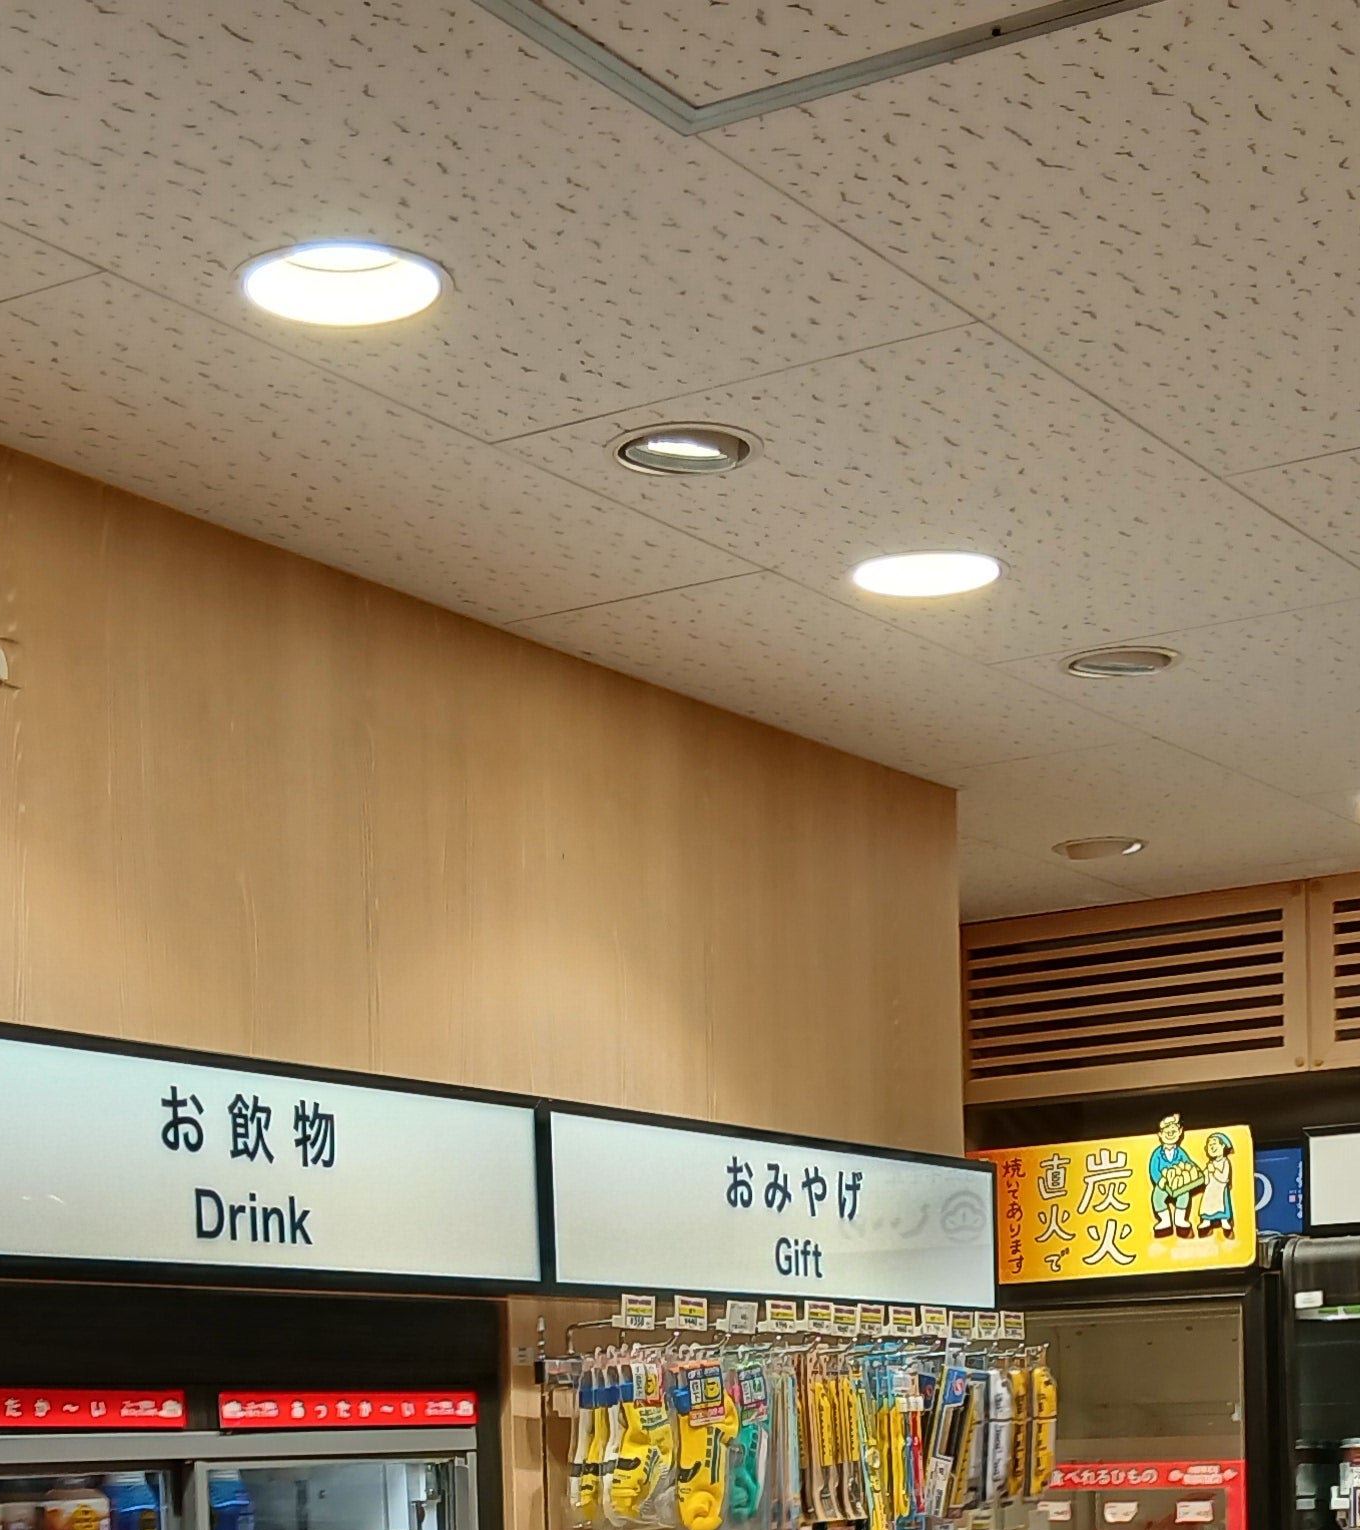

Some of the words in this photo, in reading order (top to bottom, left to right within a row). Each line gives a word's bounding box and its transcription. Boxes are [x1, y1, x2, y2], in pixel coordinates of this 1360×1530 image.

[161, 1086, 338, 1169] お飲物
[195, 1187, 313, 1247] Drink
[724, 1156, 863, 1221] おみやげ
[1002, 1157, 1026, 1275] 焼いてあります
[1034, 1152, 1076, 1273] 直火で
[1077, 1148, 1136, 1266] 炭火
[774, 1236, 822, 1280] Gift
